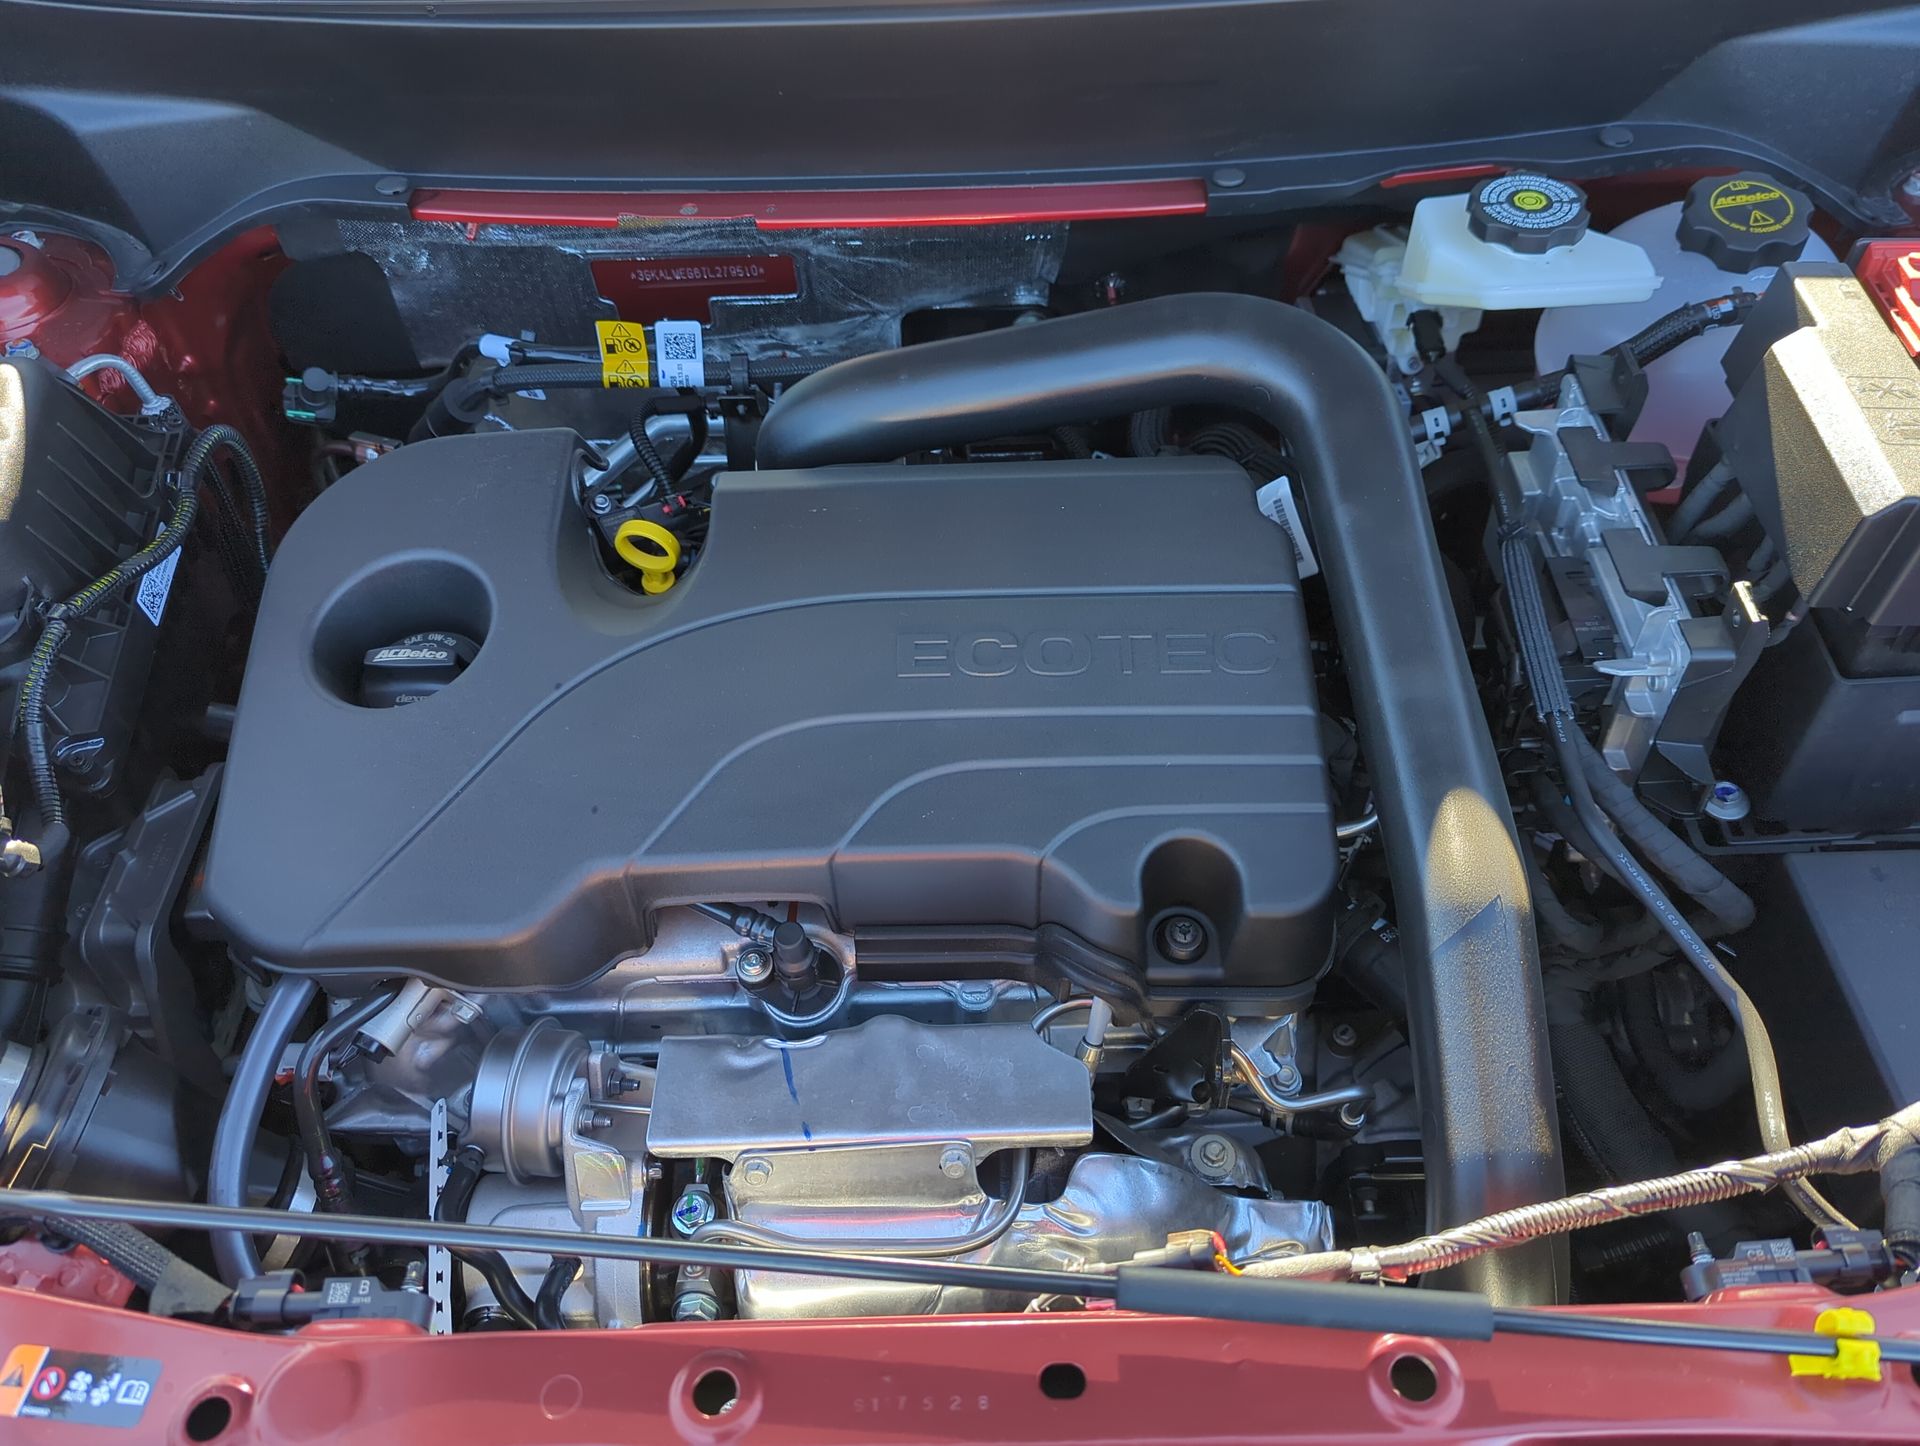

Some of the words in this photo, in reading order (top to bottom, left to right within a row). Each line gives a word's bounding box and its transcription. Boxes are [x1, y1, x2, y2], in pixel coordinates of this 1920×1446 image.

[1715, 191, 1780, 206] ACDelco
[404, 634, 424, 646] SAE
[428, 633, 457, 647] 0W-20
[374, 648, 448, 660] ACDelco
[896, 631, 1280, 678] ECOTEC
